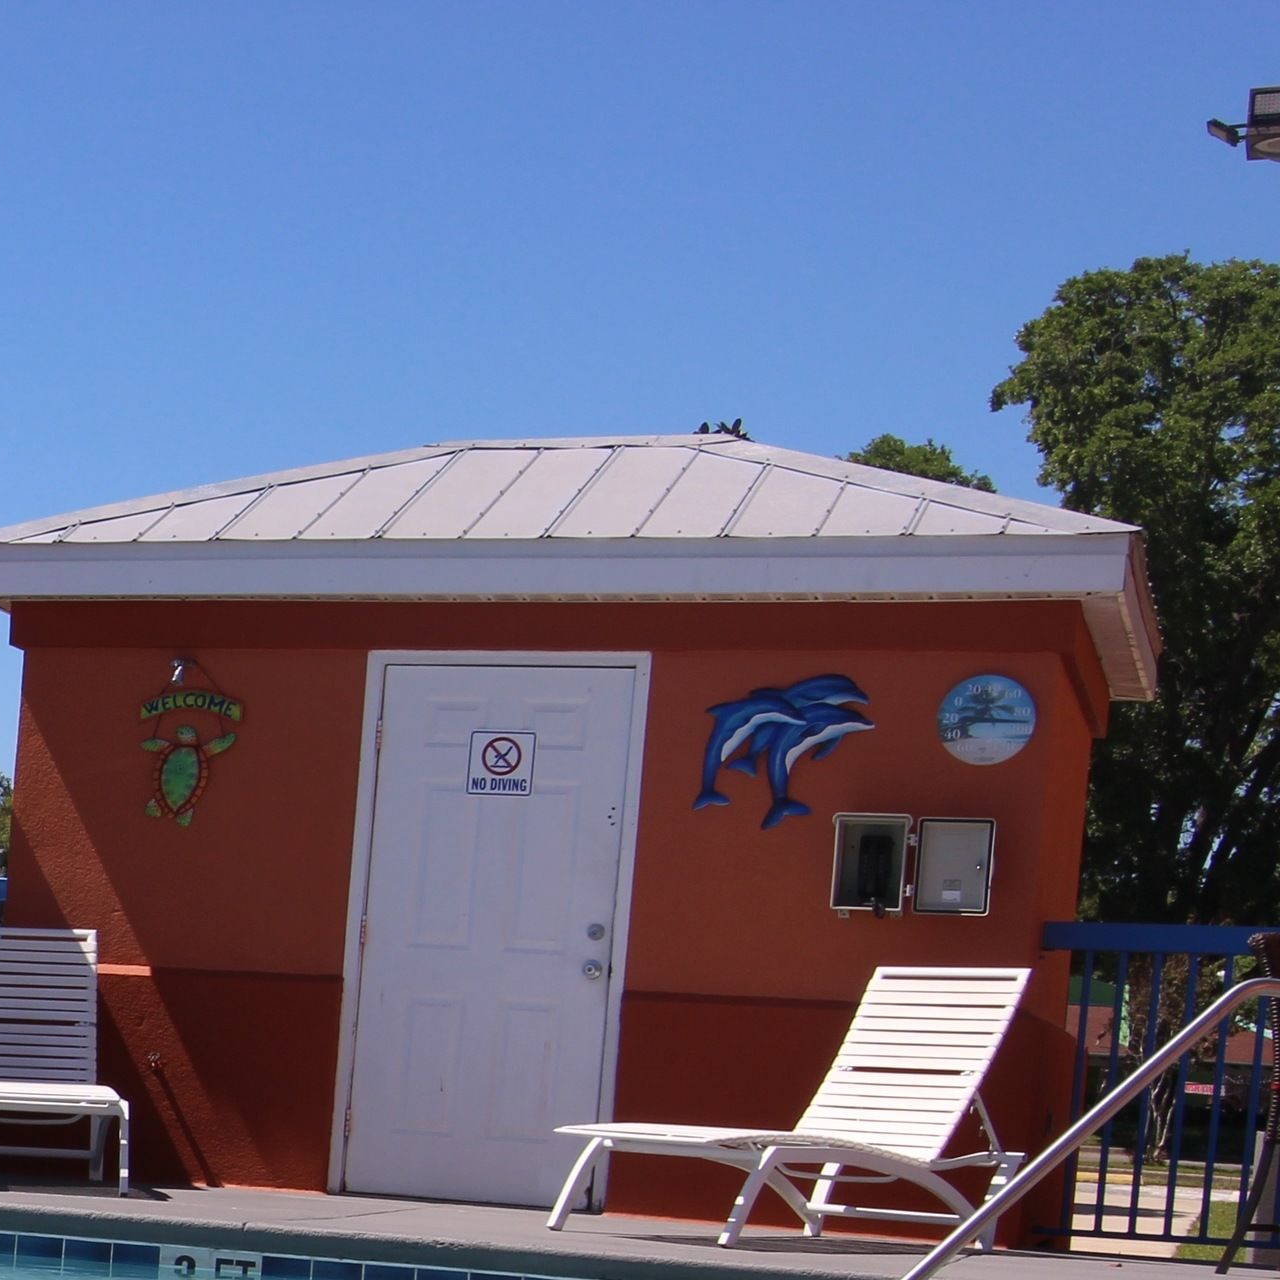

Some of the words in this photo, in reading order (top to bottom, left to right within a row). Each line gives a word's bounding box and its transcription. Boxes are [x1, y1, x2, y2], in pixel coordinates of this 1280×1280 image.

[143, 692, 237, 718] WELCOME
[471, 777, 486, 791] NO
[490, 778, 527, 792] DIVING
